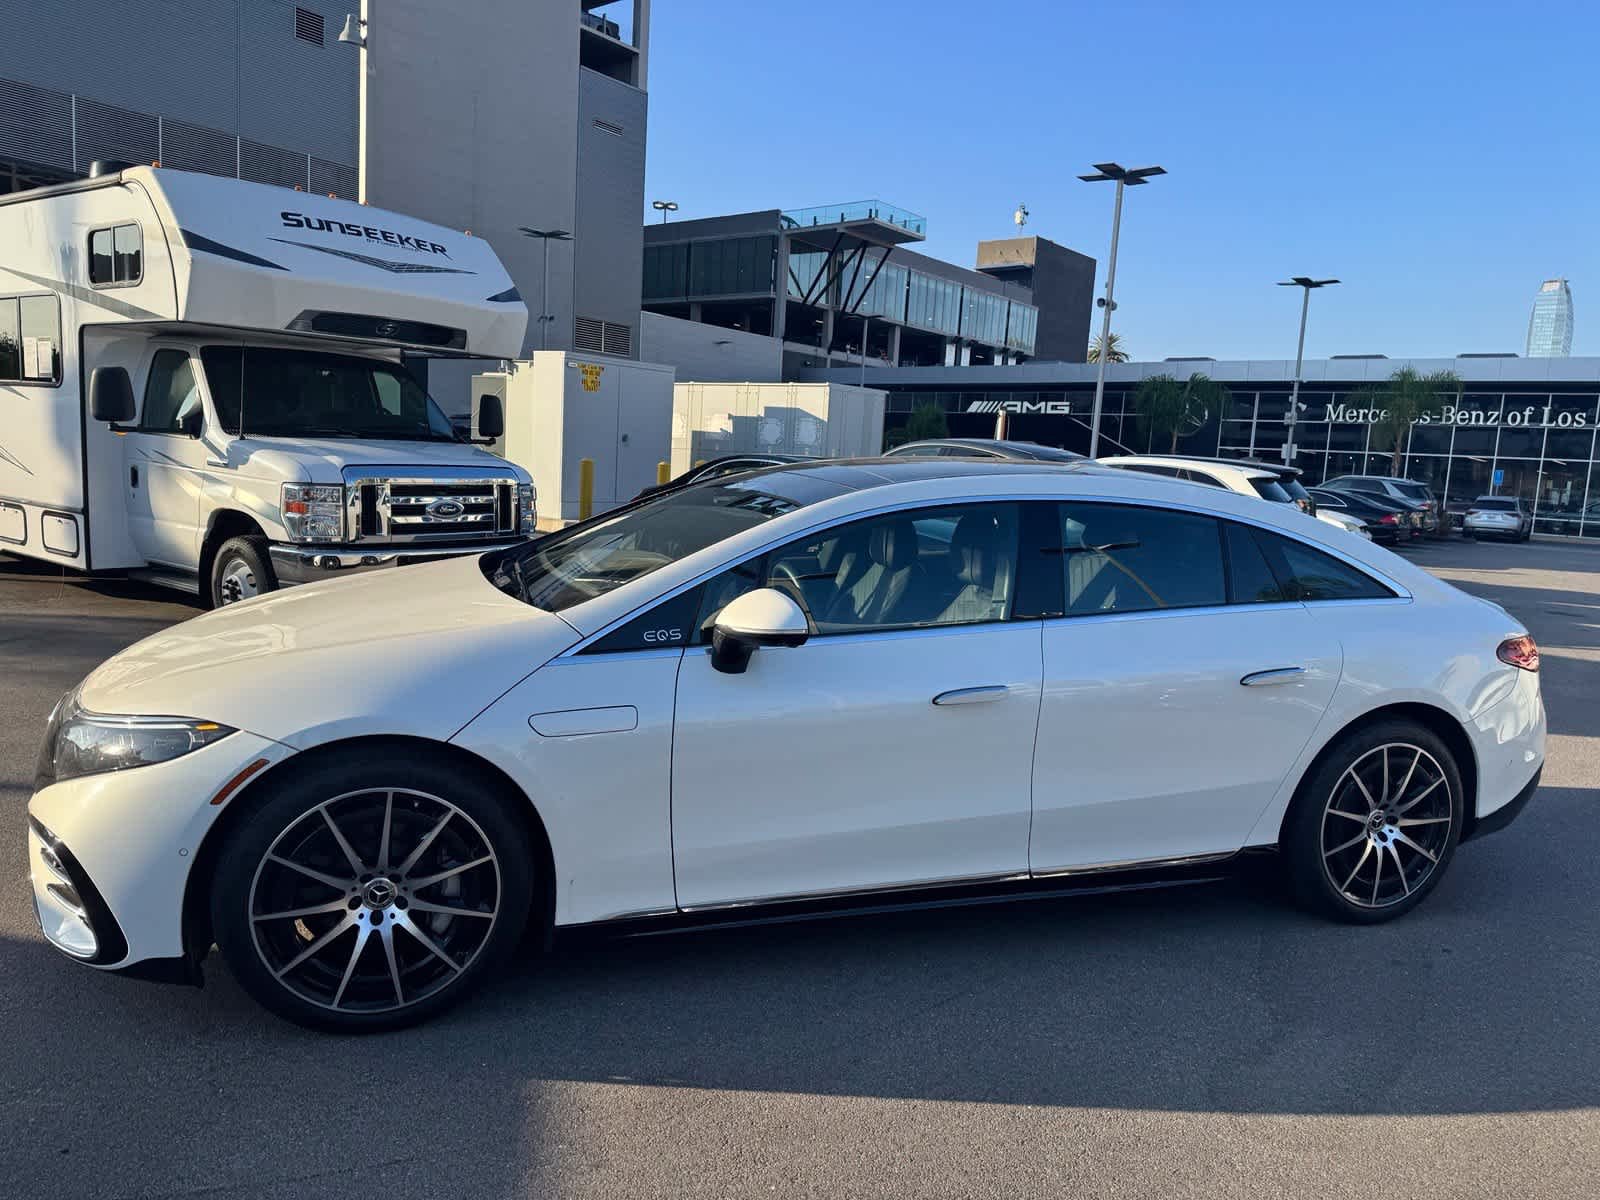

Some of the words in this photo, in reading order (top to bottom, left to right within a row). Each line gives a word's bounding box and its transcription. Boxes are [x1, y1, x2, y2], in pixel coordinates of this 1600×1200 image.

[1324, 404, 1499, 425] Merces-Benz
[1507, 406, 1535, 426] of
[1540, 406, 1586, 427] Los
[643, 628, 682, 642] EQS
